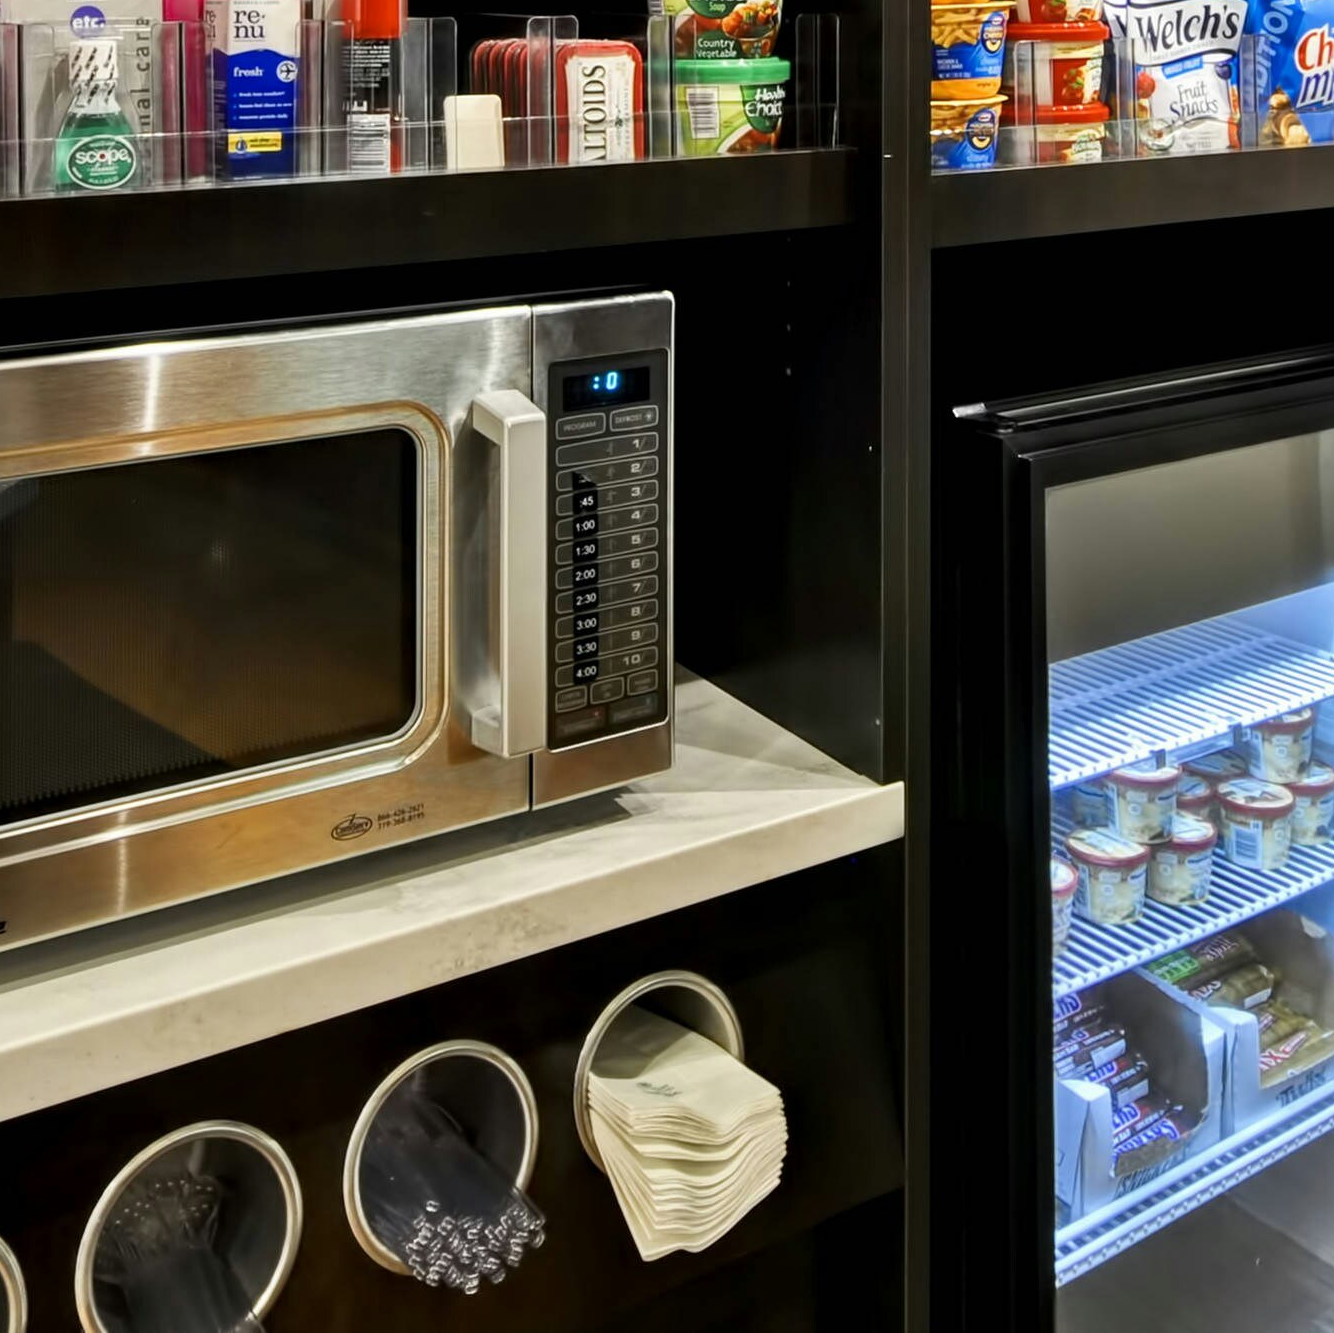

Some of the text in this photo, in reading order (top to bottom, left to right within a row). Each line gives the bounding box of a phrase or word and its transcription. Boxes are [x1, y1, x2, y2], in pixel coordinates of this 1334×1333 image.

[709, 2, 727, 12] Soup
[72, 15, 105, 29] etc.
[1134, 4, 1240, 52] Welch's
[233, 25, 266, 39] nu
[697, 38, 735, 52] Country
[697, 49, 738, 59] Vegetable
[233, 66, 264, 78] fresh
[1178, 81, 1208, 104] Fruit
[1169, 98, 1219, 118] Snacks
[75, 147, 130, 166] scope
[593, 371, 618, 390] :0
[563, 420, 597, 433] PROGRAM
[575, 518, 595, 532] 1:00
[575, 543, 596, 556] 1:30
[575, 568, 596, 582] 2:00
[575, 592, 597, 606] 2:30
[576, 617, 597, 631] 3:00
[576, 641, 597, 655] 3:30
[576, 665, 597, 678] 4:00
